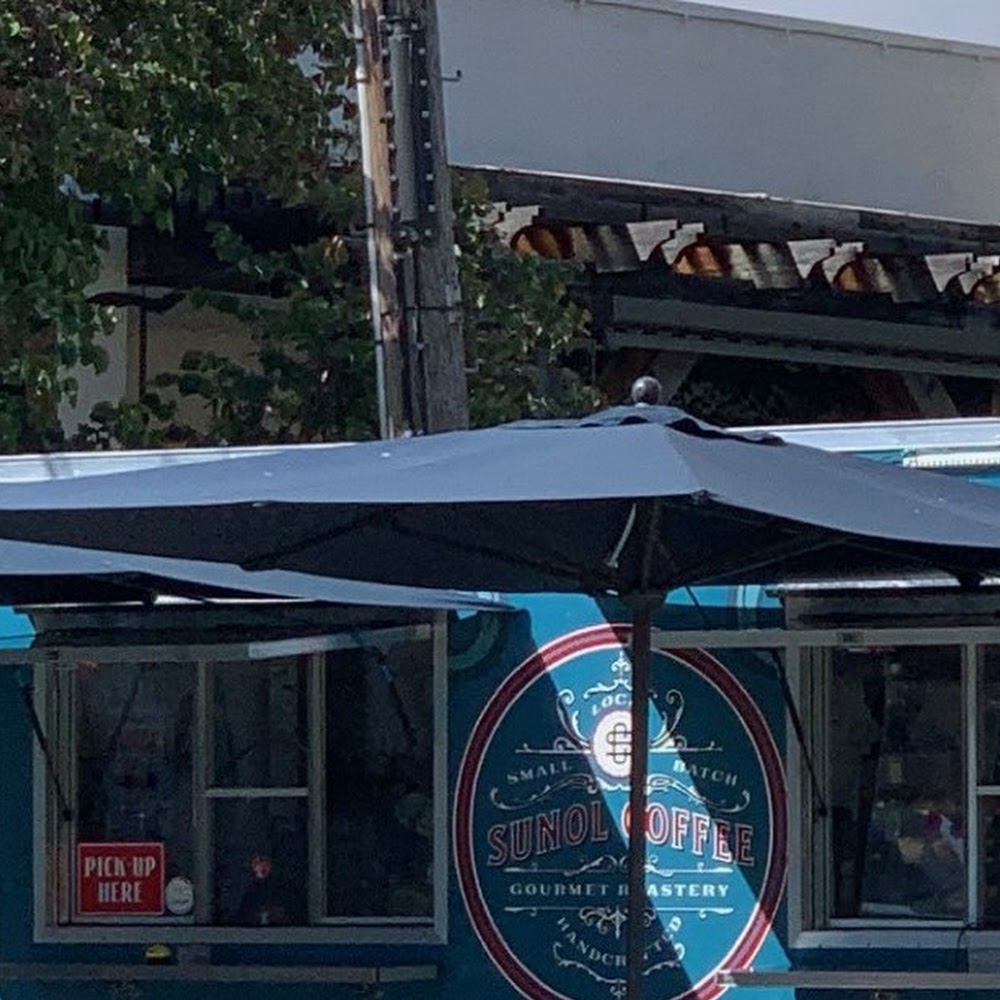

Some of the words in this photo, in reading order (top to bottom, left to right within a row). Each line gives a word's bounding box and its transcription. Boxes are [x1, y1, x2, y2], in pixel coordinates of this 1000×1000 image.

[507, 760, 573, 784] SMALL
[673, 759, 738, 787] BATCH
[487, 801, 608, 866] SUNOL
[84, 856, 126, 878] PICK
[132, 856, 156, 878] UP
[98, 881, 142, 903] HERE
[509, 883, 608, 898] GOURMET
[618, 882, 730, 898] RASTERY
